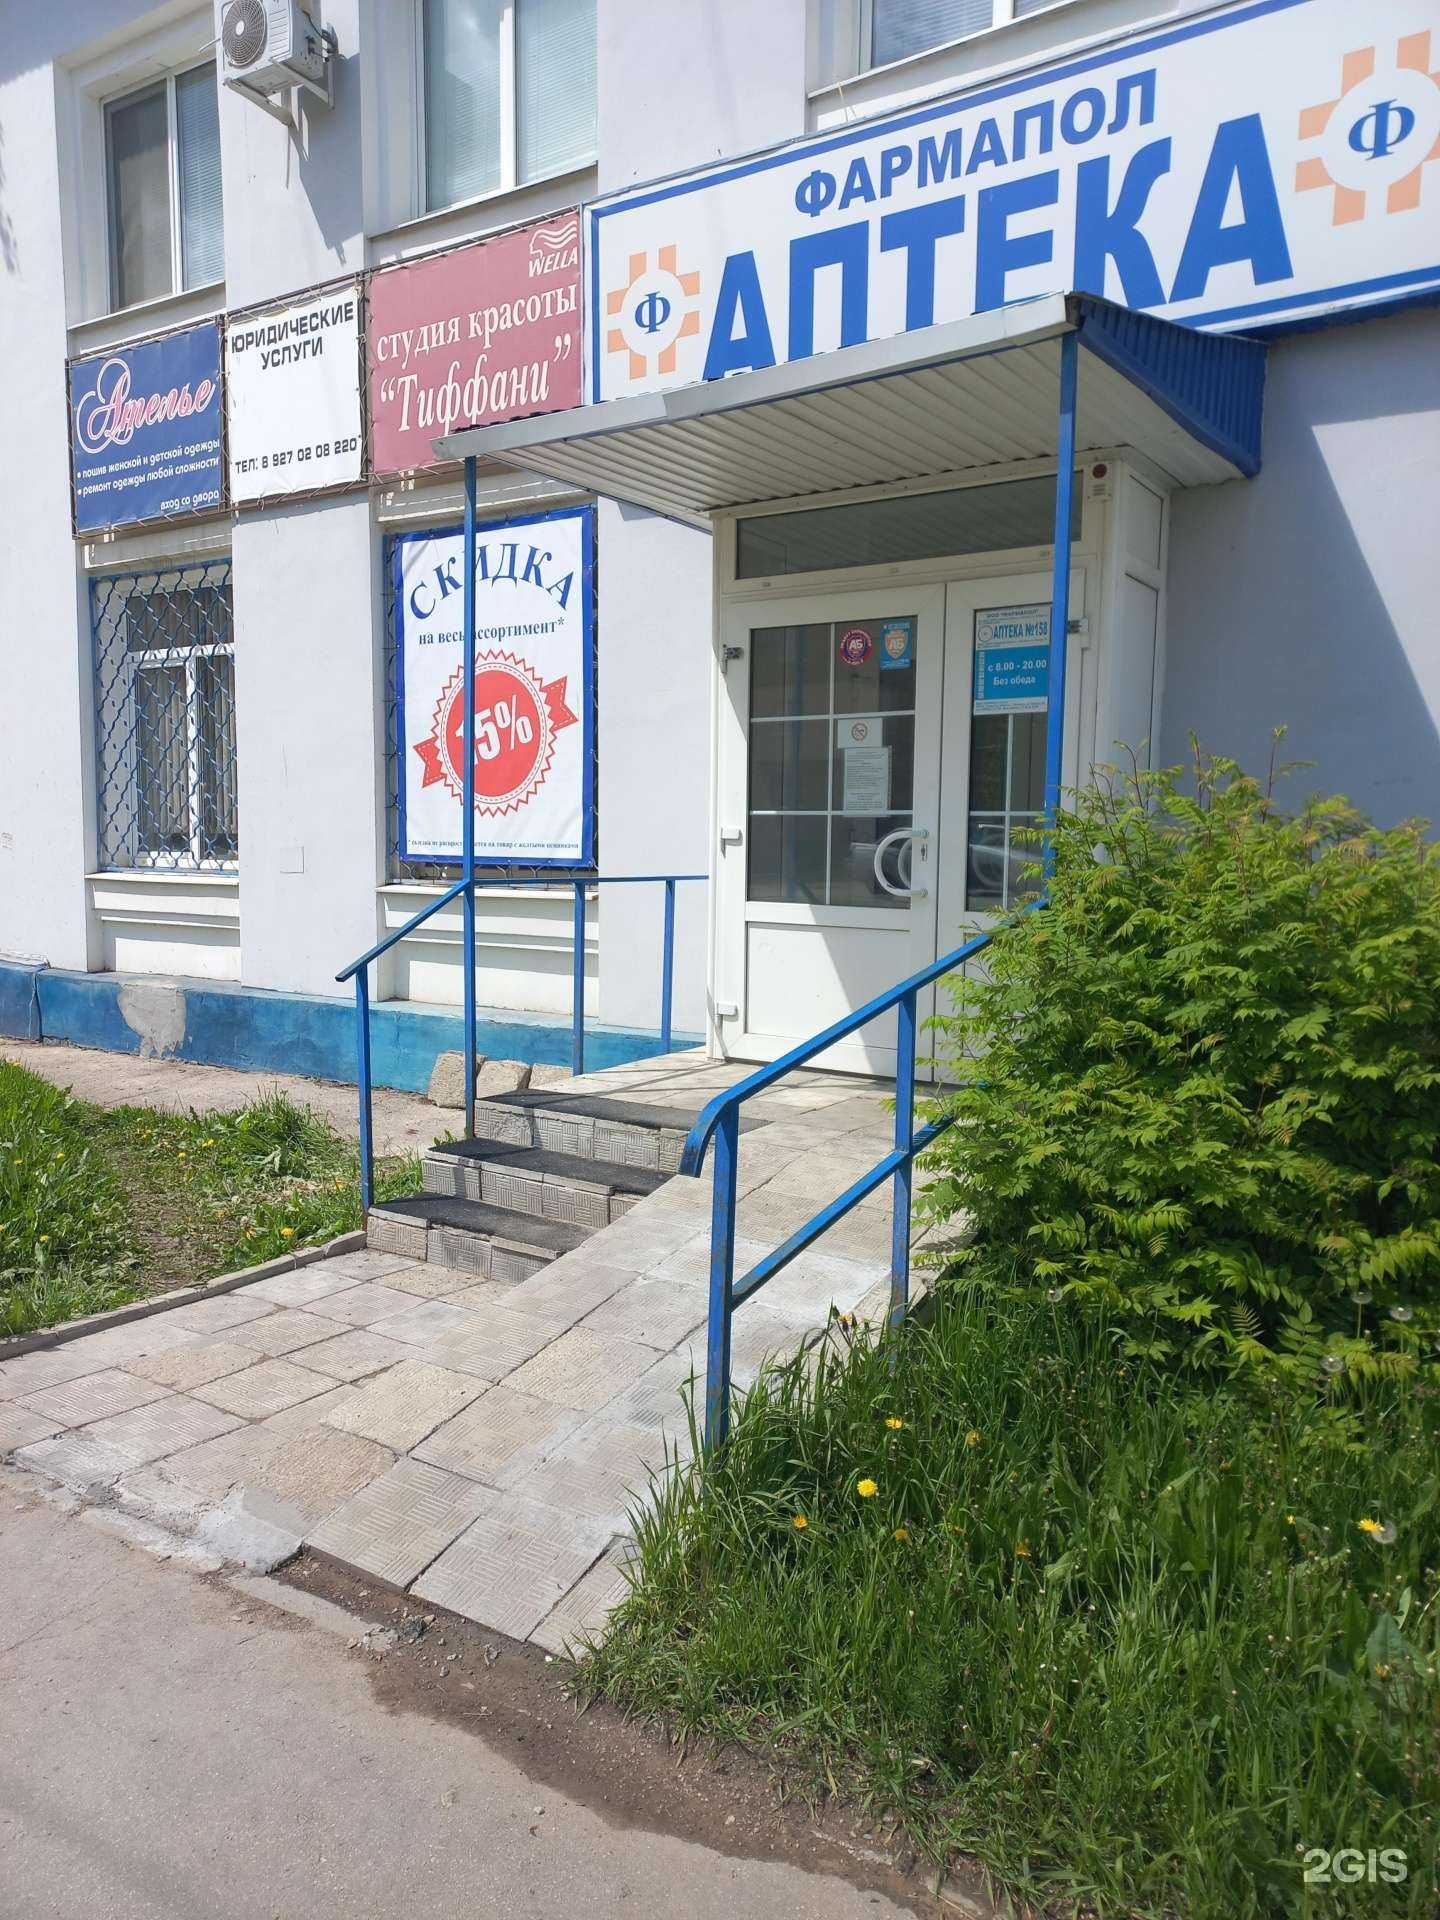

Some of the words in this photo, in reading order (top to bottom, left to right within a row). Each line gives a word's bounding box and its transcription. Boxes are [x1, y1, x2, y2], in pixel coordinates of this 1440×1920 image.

[793, 68, 1156, 217] ФАРМАПОЛ
[528, 247, 578, 277] WELLA
[702, 113, 1294, 382] АПТЕКА
[231, 301, 354, 354] ЮРИДИЧЕСКИЕ
[377, 316, 461, 369] студия
[468, 284, 577, 350] красоты
[261, 336, 323, 370] УСЛУГИ
[76, 358, 216, 454] Ателье
[82, 464, 107, 478] пошив
[109, 455, 142, 473] женской
[143, 456, 148, 465] и
[150, 446, 183, 465] детской
[184, 439, 220, 455] одежды
[262, 456, 269, 469] 8
[272, 450, 293, 467] 927
[297, 446, 311, 462] 02
[315, 443, 330, 458] 08
[334, 437, 357, 454] 220
[82, 481, 112, 498] ремонт
[113, 474, 146, 491] одежды
[147, 467, 174, 481] любой
[175, 457, 219, 474] сложности
[160, 497, 180, 511] вход
[181, 495, 191, 506] со
[193, 490, 219, 507] двора
[419, 632, 434, 645] на
[993, 622, 1024, 640] АПТЕКА
[993, 676, 1008, 686] Без
[1010, 675, 1036, 686] обеда
[1022, 659, 1047, 670] 20.00
